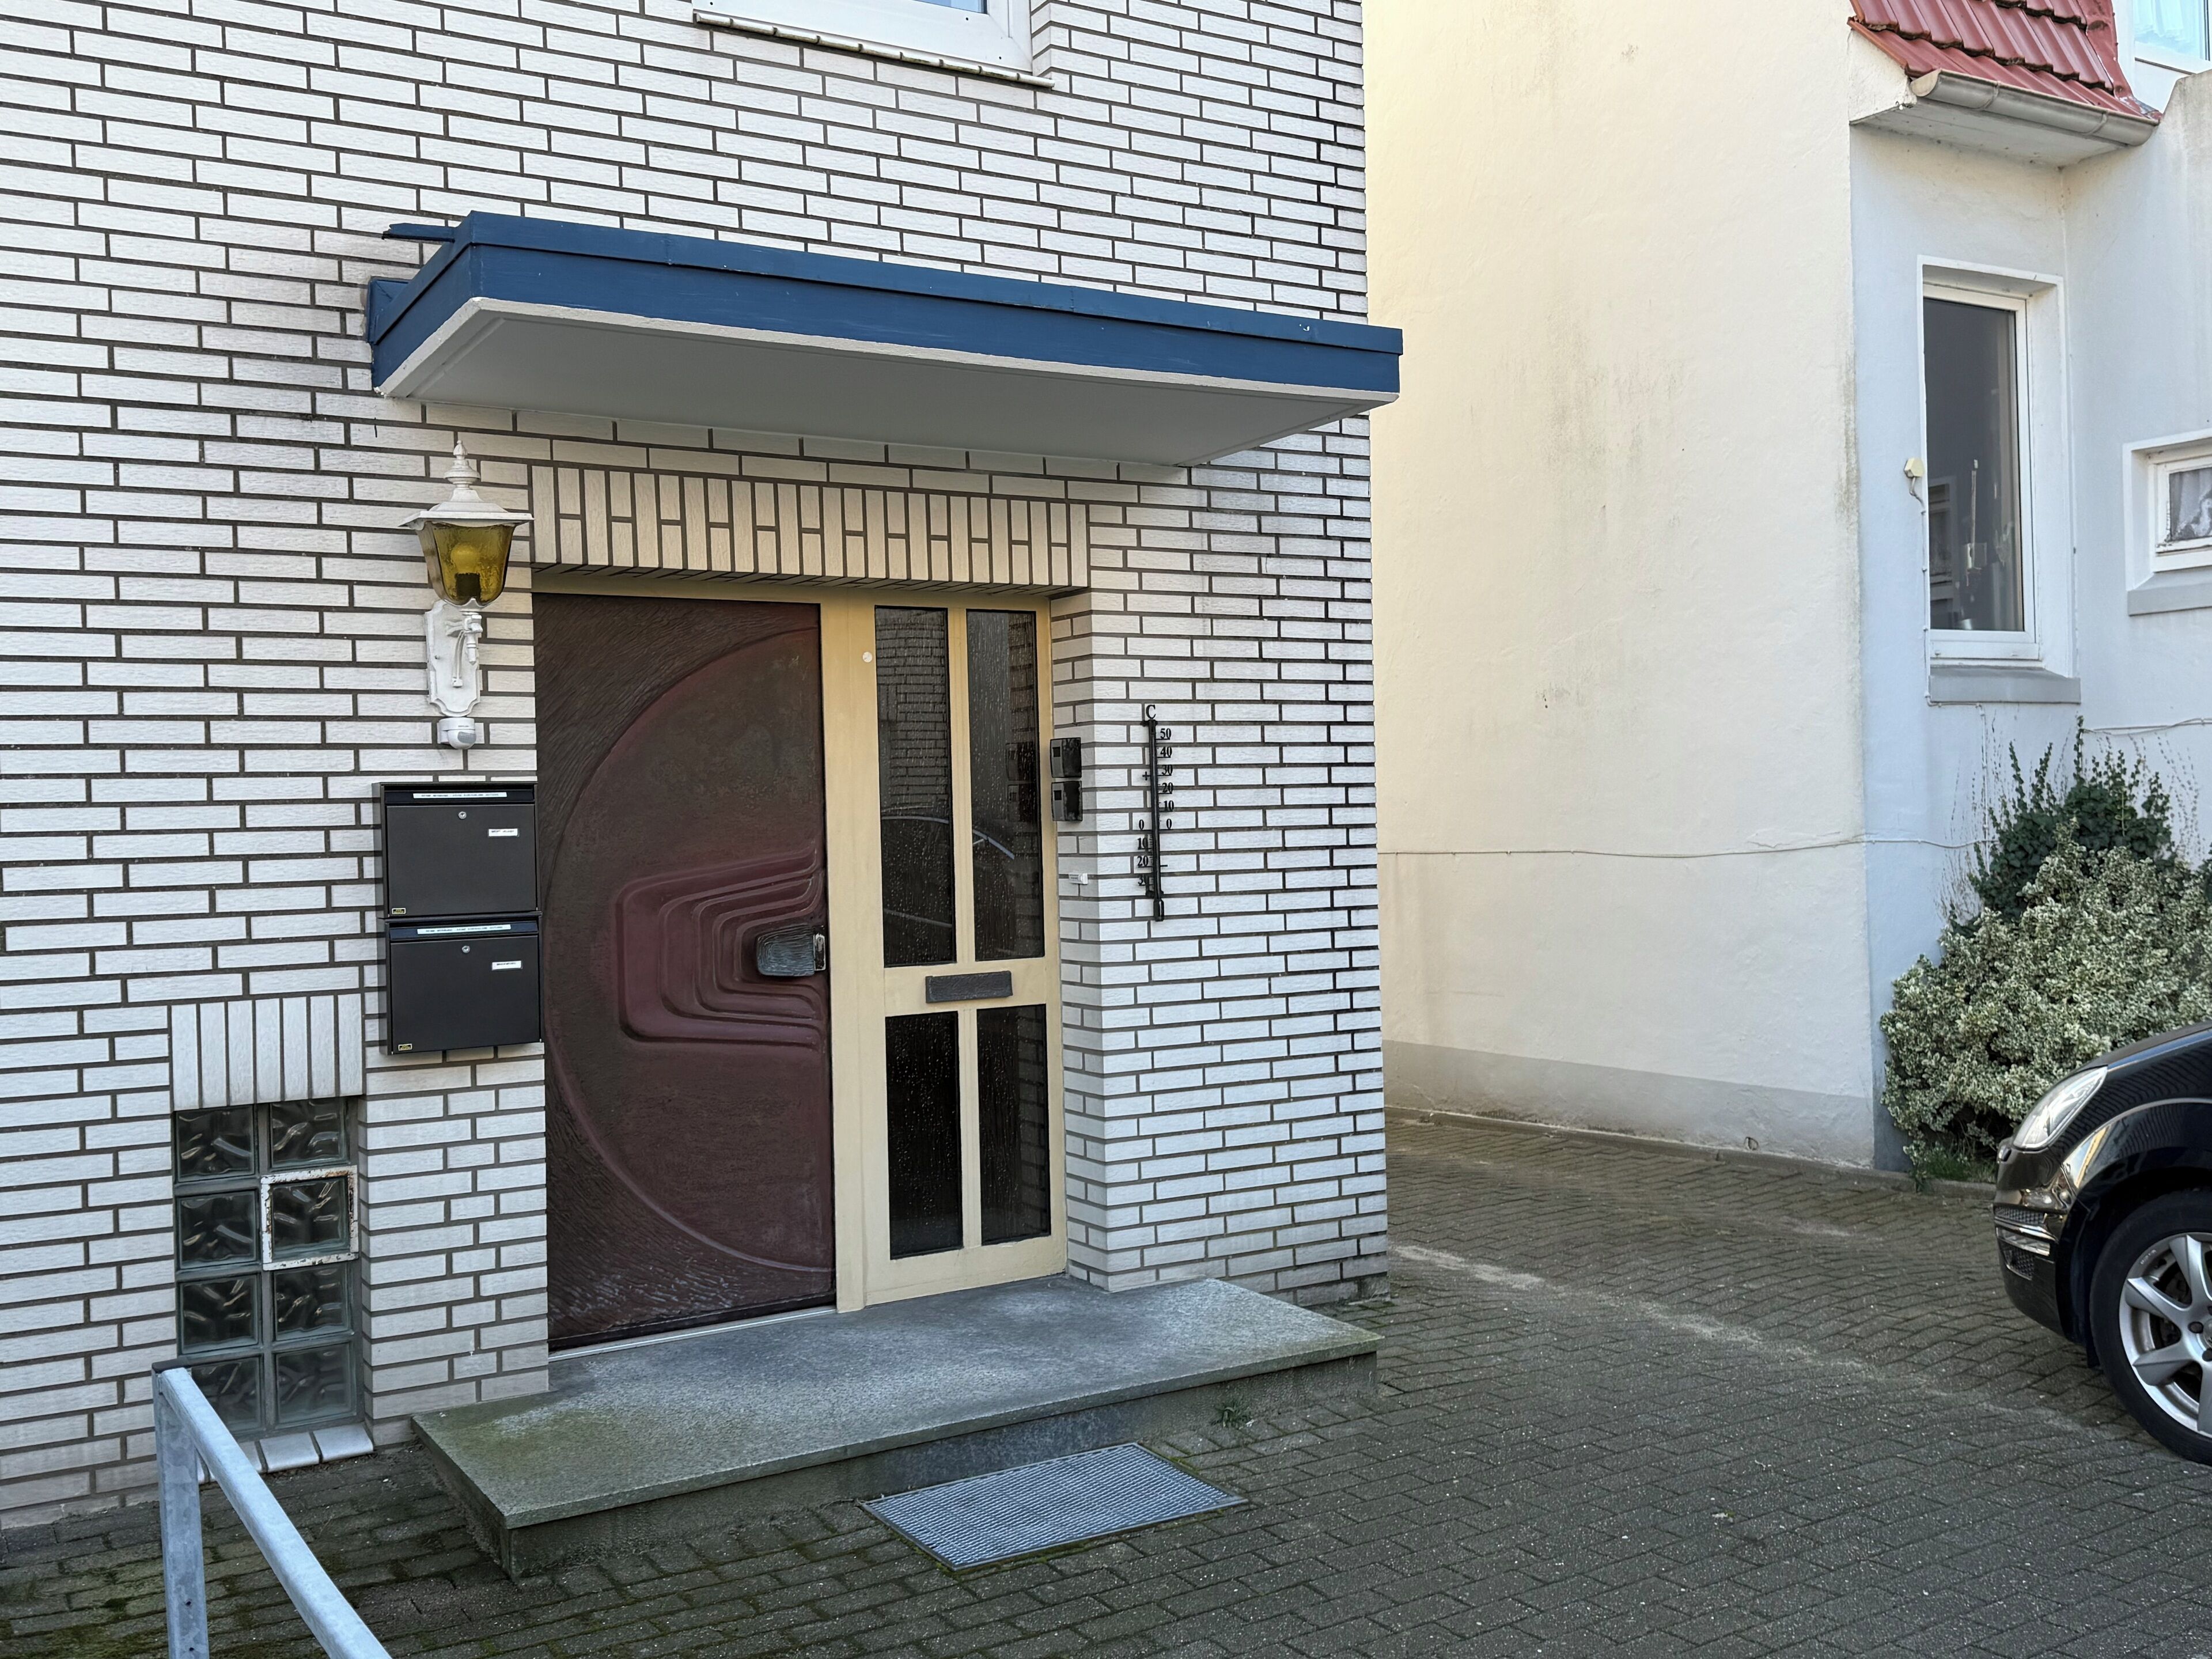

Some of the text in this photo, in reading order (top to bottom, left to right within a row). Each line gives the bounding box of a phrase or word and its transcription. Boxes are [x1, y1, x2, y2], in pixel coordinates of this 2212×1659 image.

[1146, 704, 1156, 719] C
[1160, 728, 1172, 739] 50
[1160, 747, 1172, 757] 40
[1162, 764, 1173, 775] 30
[1162, 782, 1174, 793] 20
[1164, 800, 1175, 812] 10
[1139, 819, 1145, 830] 0
[1166, 818, 1172, 830] 0
[1137, 838, 1148, 849] 10
[1137, 855, 1149, 866] 20
